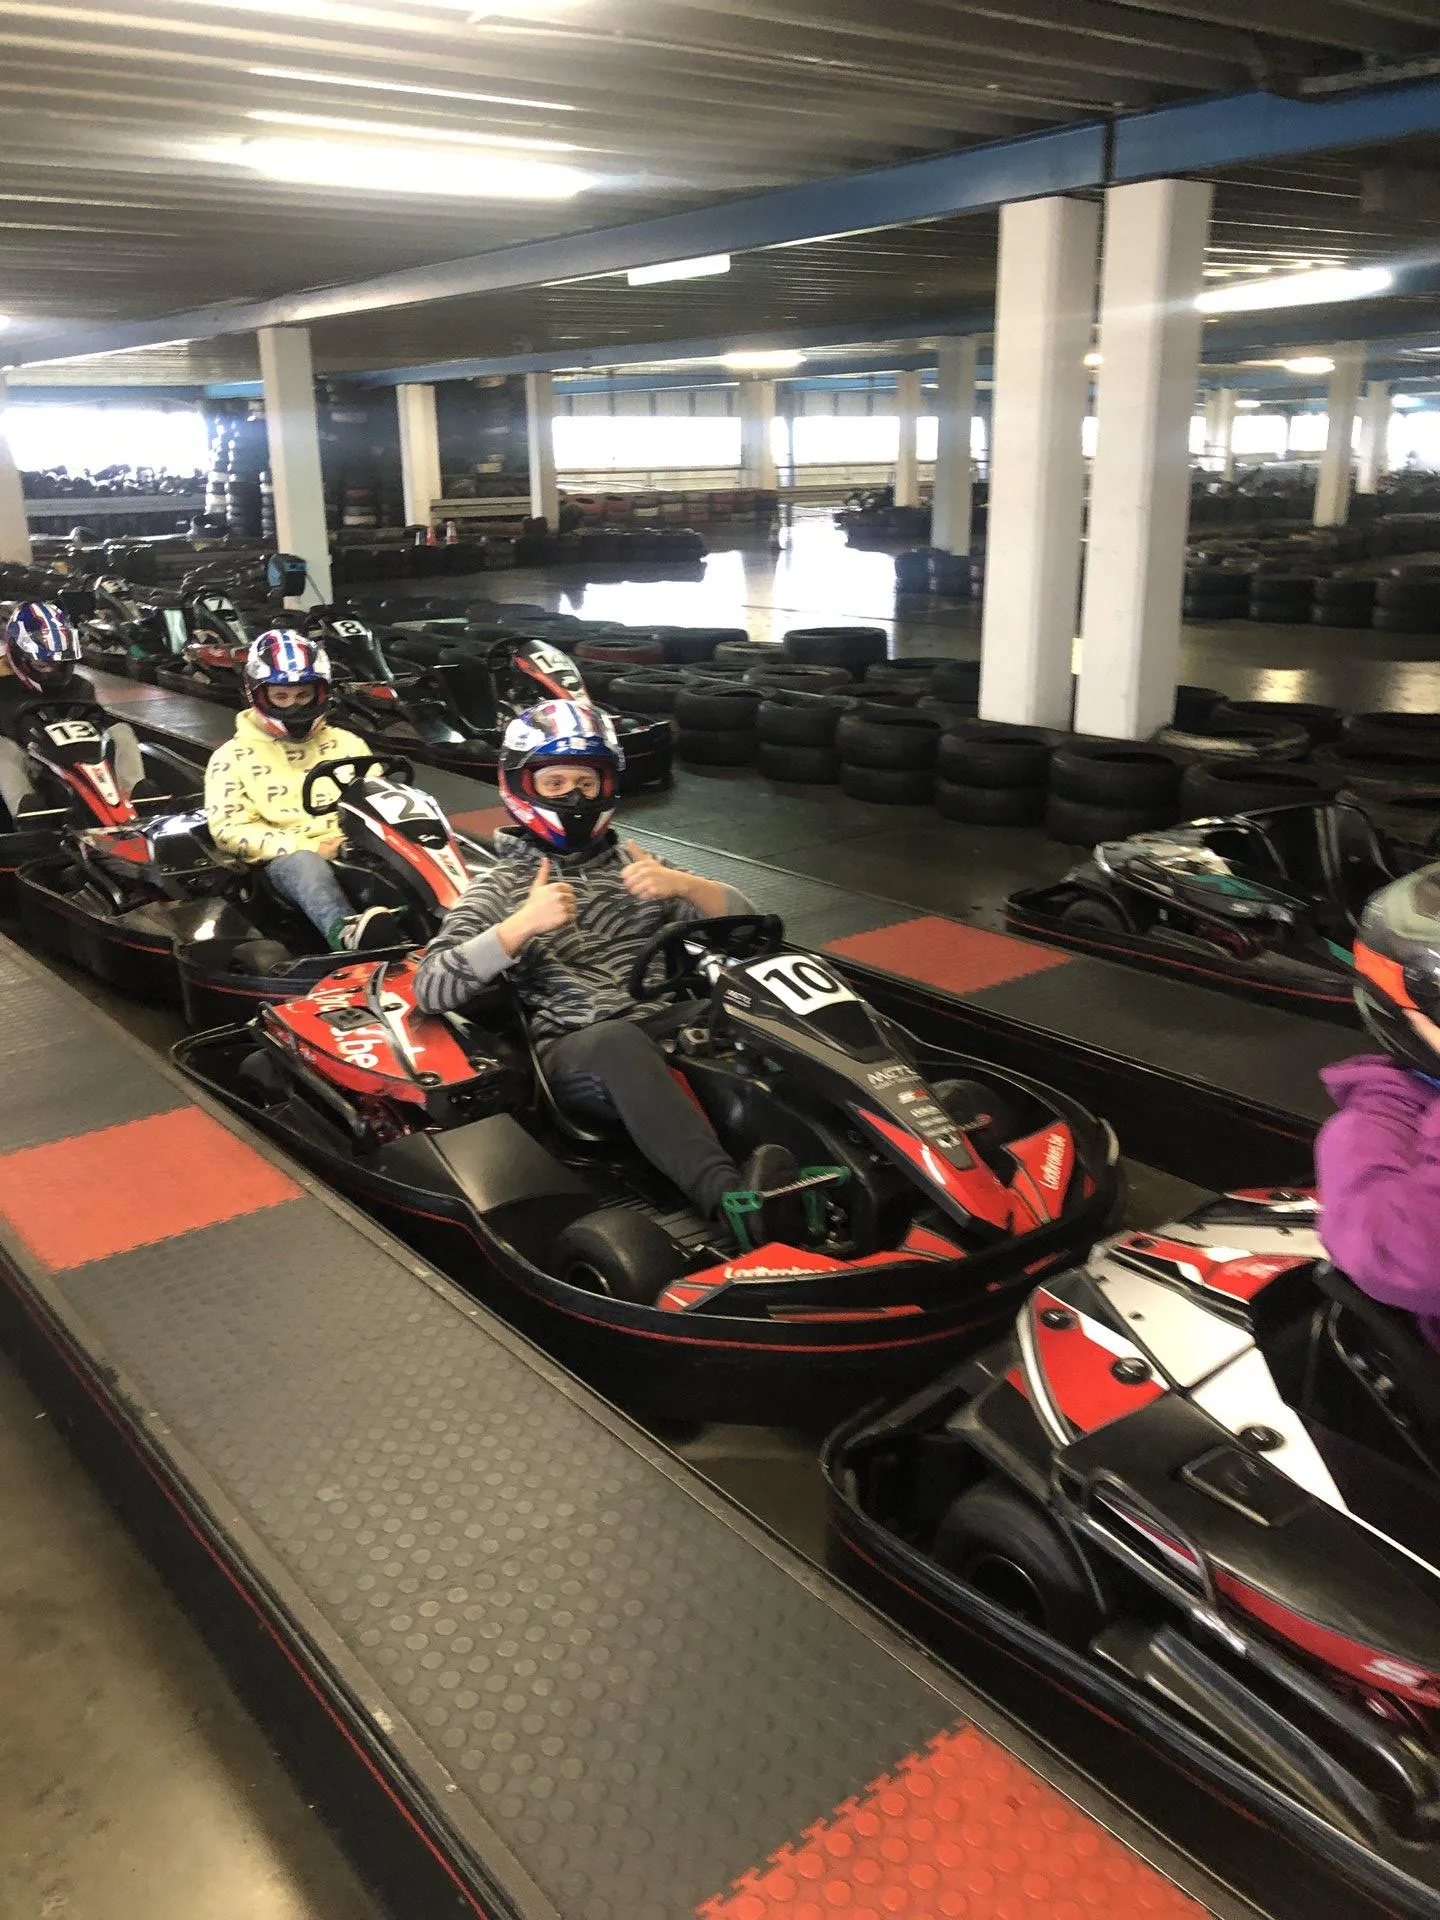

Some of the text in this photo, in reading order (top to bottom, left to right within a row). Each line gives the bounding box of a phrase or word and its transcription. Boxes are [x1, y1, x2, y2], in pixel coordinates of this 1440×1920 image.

[339, 621, 364, 635] 8
[52, 724, 98, 740] 13
[380, 791, 430, 821] 2
[762, 961, 840, 1001] 10
